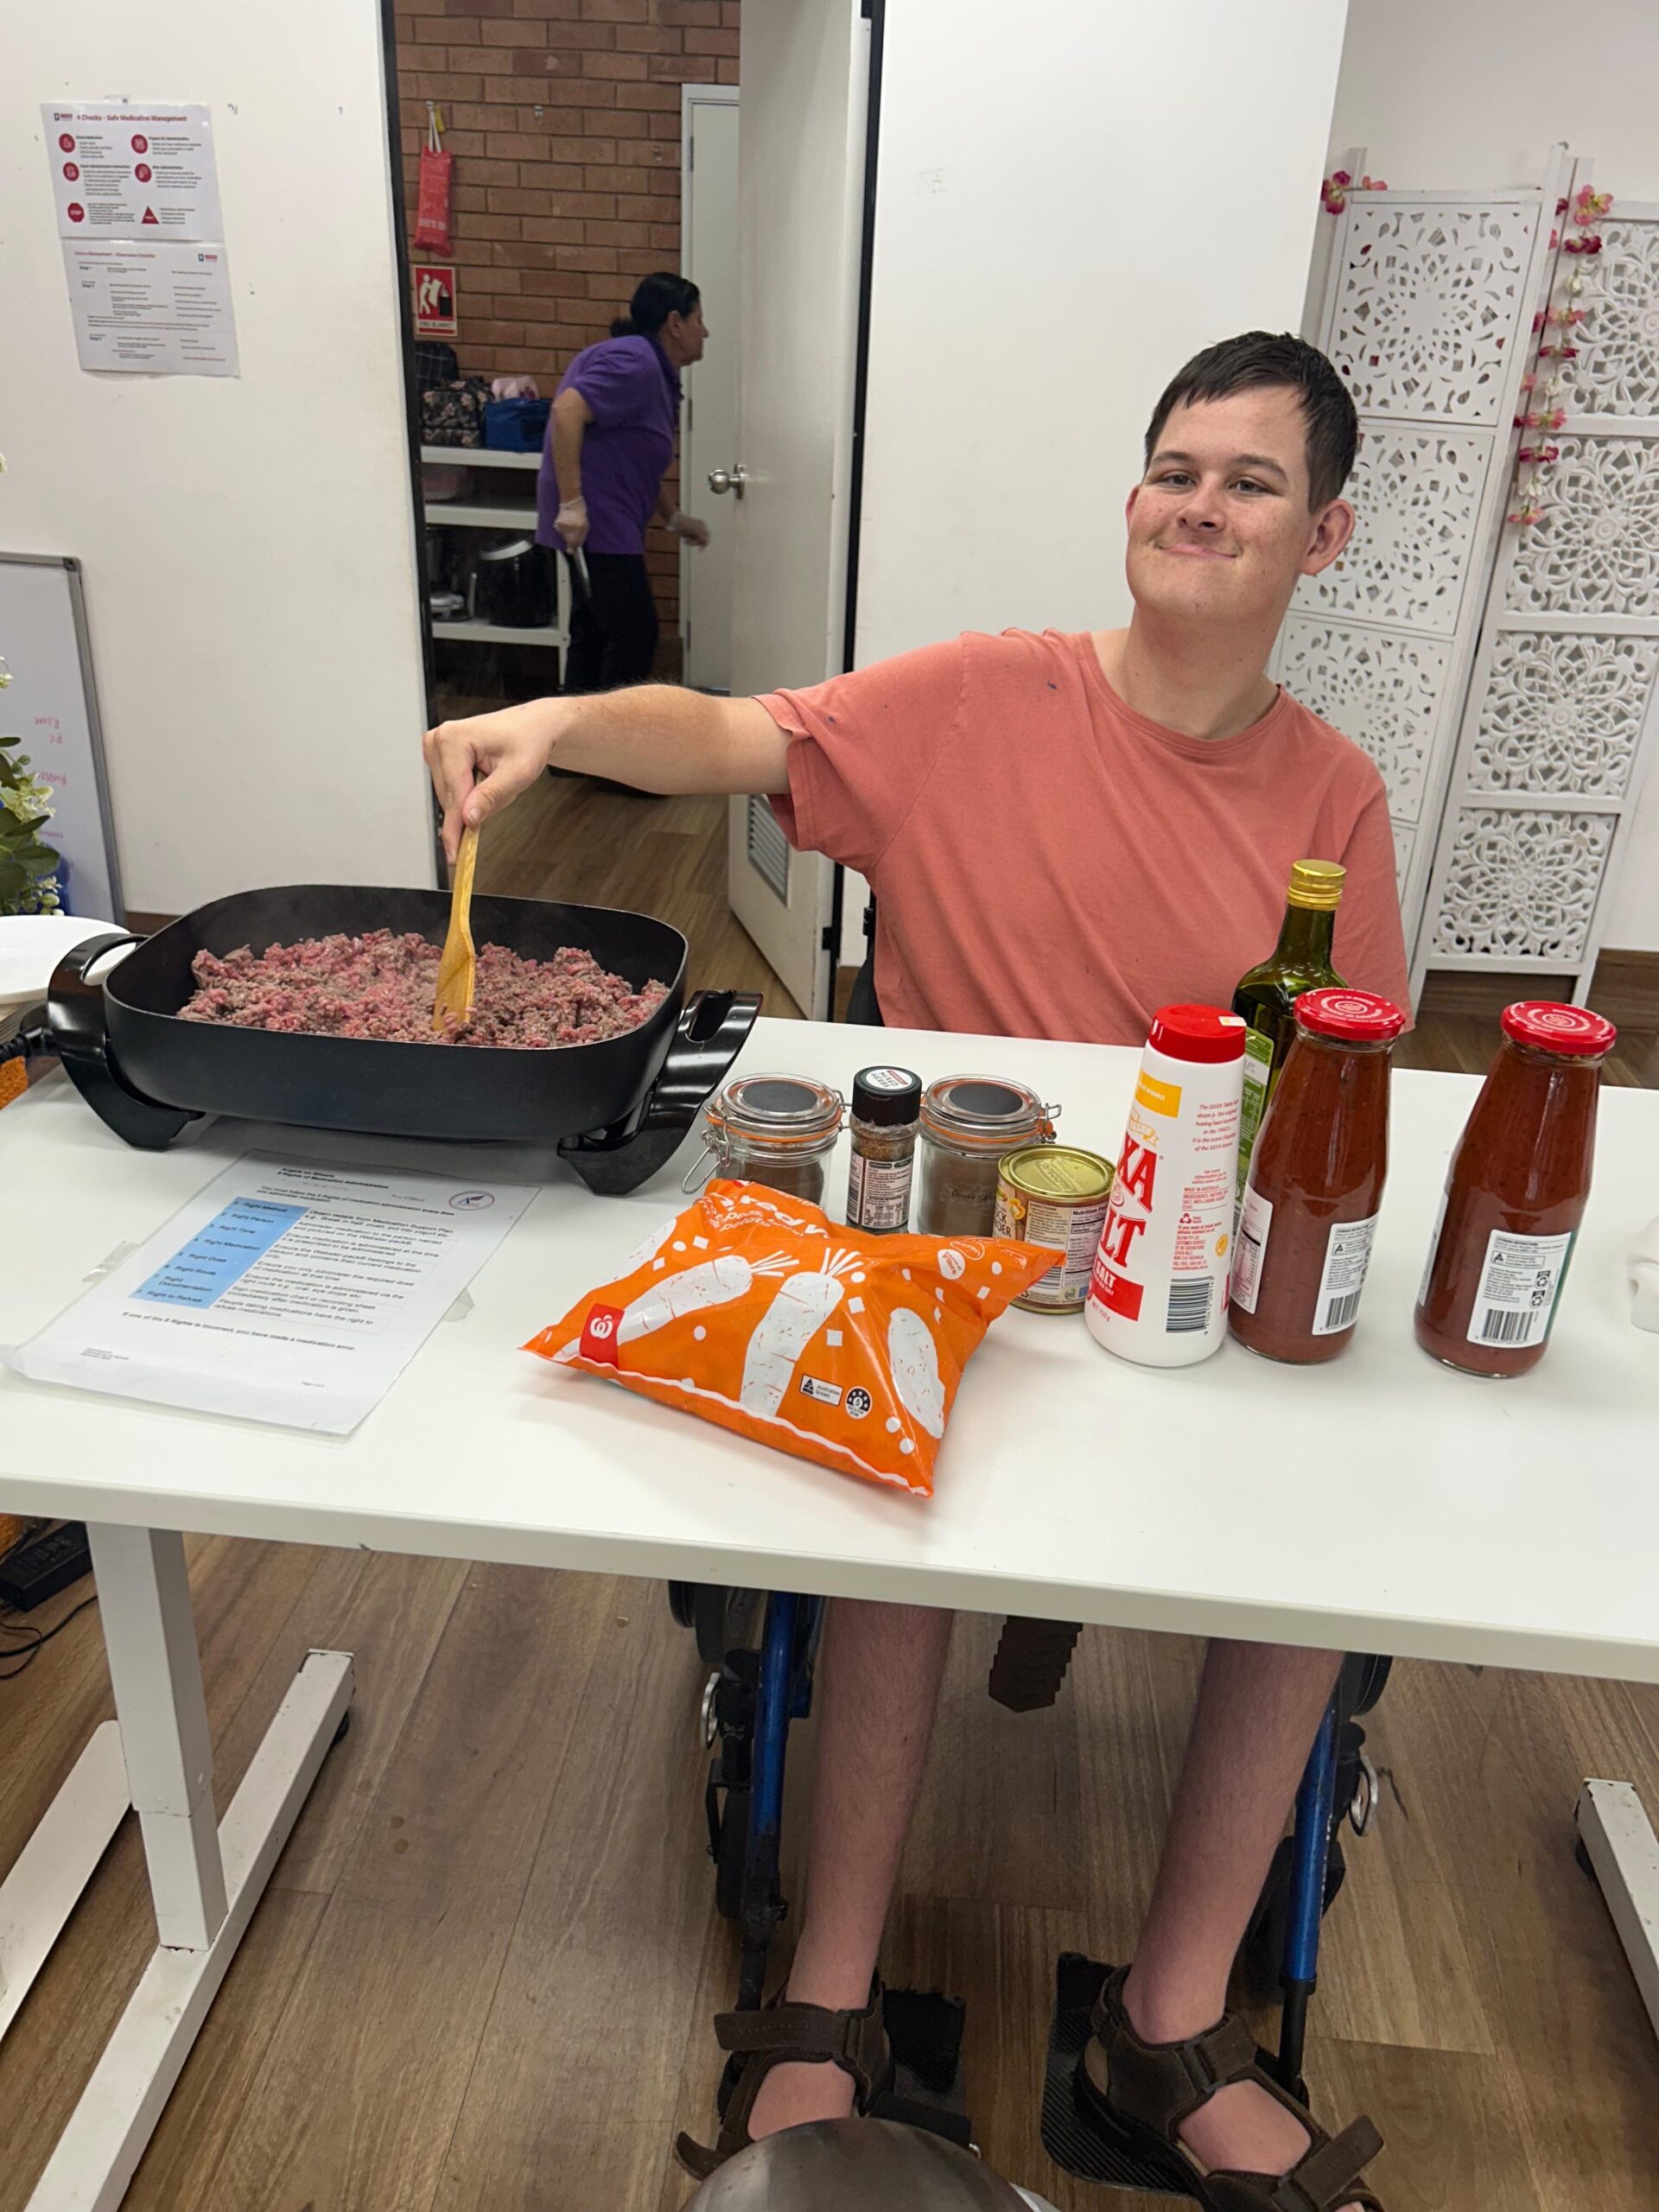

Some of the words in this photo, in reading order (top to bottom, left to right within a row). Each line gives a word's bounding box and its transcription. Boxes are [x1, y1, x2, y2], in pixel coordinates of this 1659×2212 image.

[870, 1072, 891, 1088] HERBS
[878, 1071, 899, 1087] MIXED
[1117, 1133, 1159, 1213] XA
[1099, 1208, 1146, 1268] LT
[942, 1253, 957, 1275] Fibre
[1096, 1260, 1117, 1288] SALT
[816, 1389, 830, 1398] Grown
[817, 1384, 840, 1395] Australian
